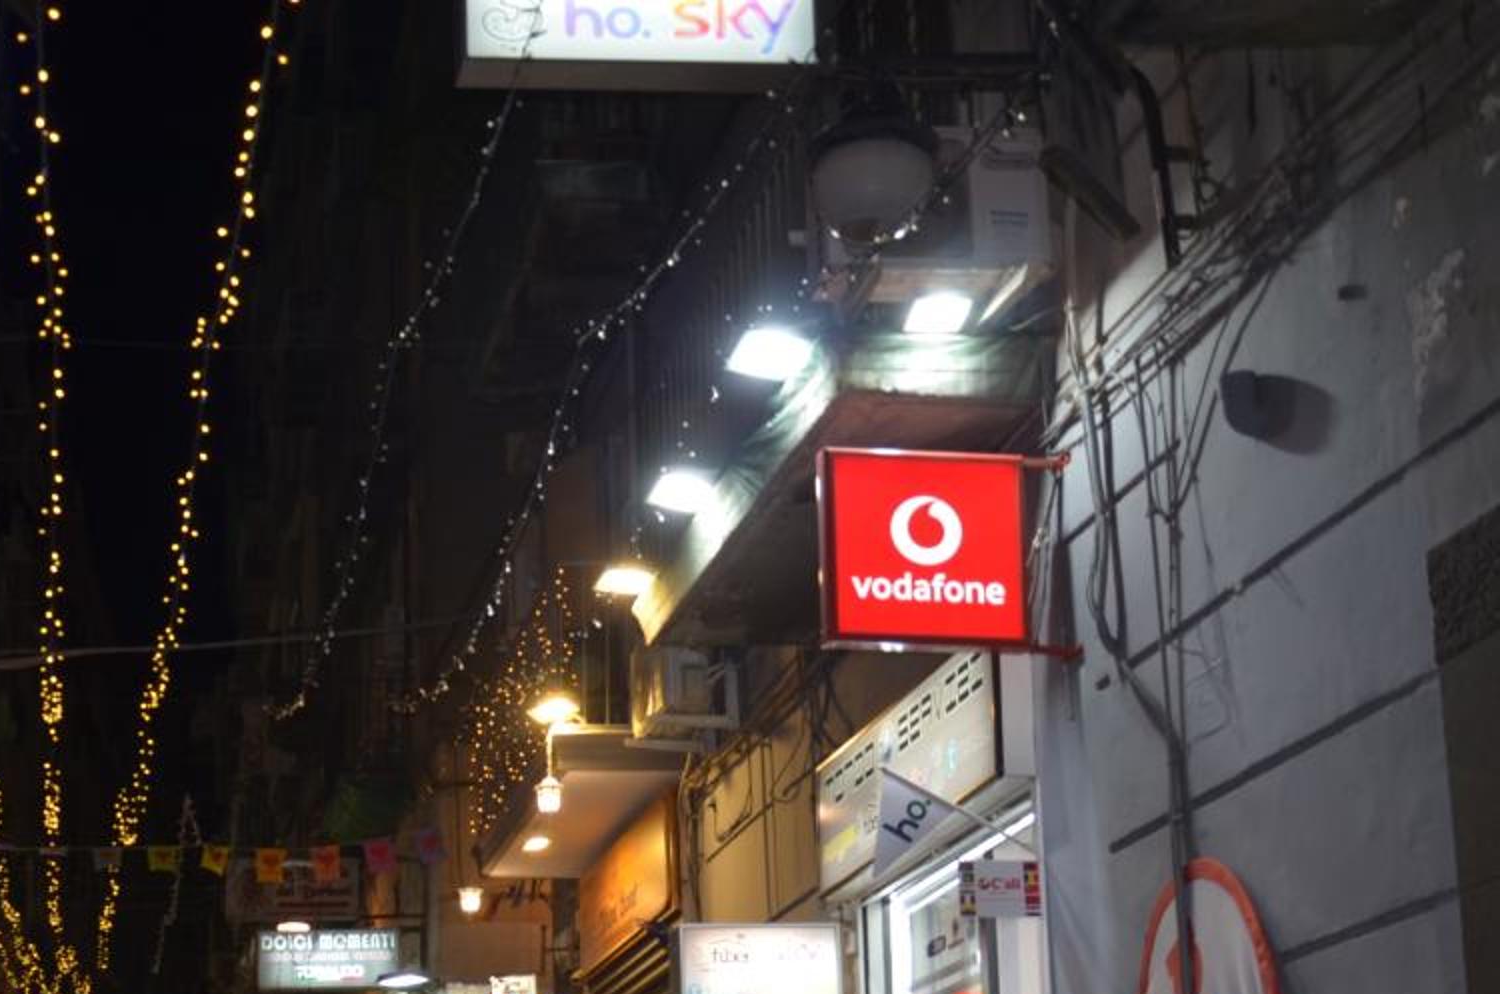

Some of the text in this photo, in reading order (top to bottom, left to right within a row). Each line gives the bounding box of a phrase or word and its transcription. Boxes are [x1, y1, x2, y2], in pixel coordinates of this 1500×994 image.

[851, 571, 1007, 606] vodafone
[882, 798, 933, 843] ho.
[319, 932, 396, 950] MOMENTI
